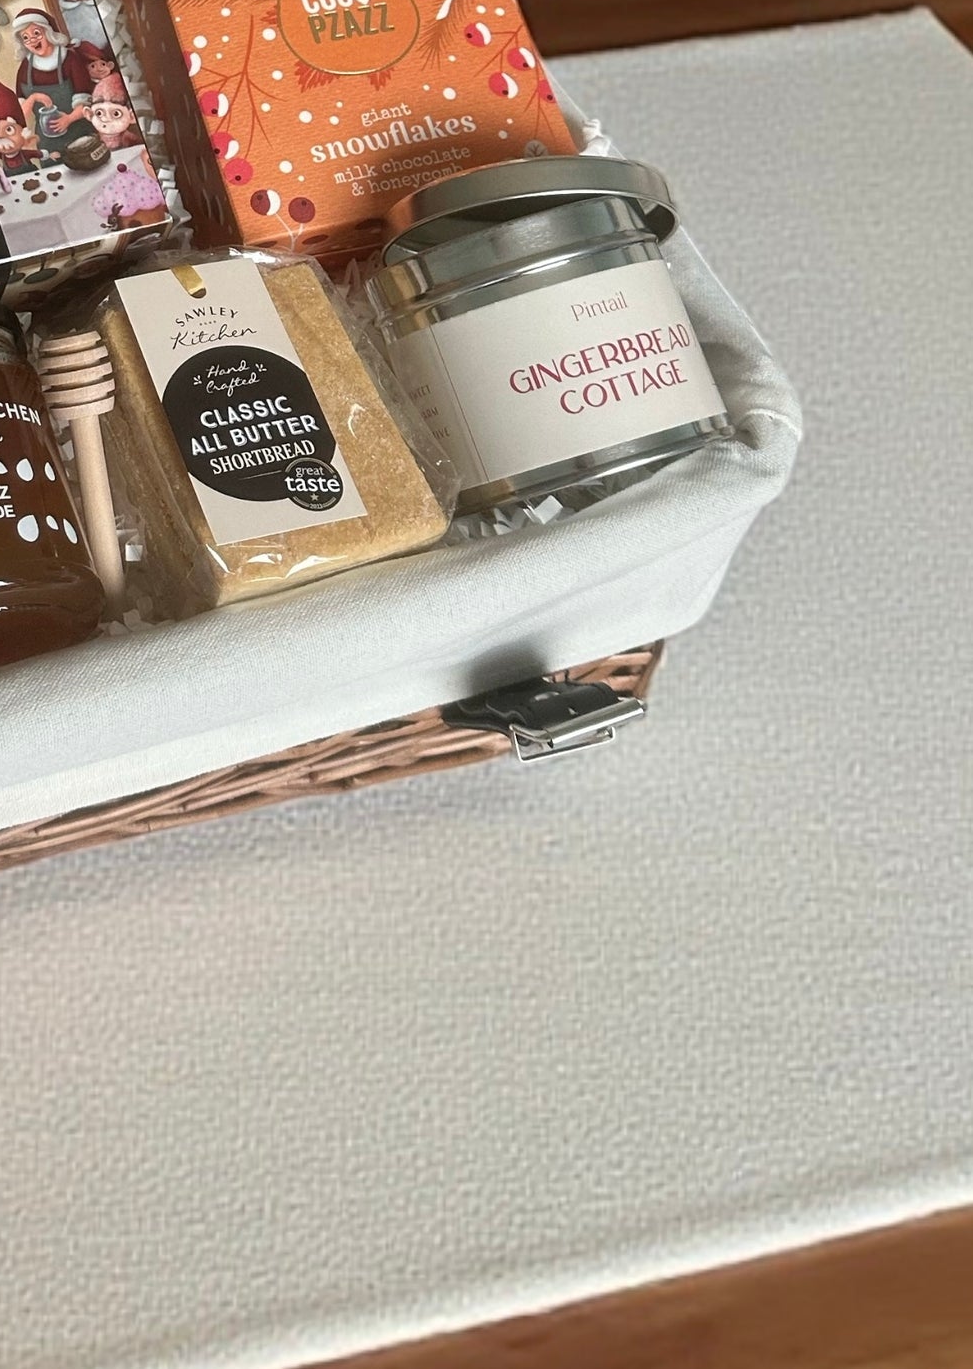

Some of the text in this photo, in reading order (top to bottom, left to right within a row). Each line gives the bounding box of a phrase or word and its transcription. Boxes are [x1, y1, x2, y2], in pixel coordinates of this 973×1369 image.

[307, 2, 395, 44] PZAZZ
[361, 102, 412, 127] giant
[309, 115, 477, 163] snowflakes
[333, 146, 472, 185] milk chocolate
[351, 163, 464, 197] & honeycomb
[175, 306, 238, 328] SAWLEY
[570, 291, 628, 322] Pintail
[171, 323, 257, 350] Kitchen
[206, 360, 250, 378] Hand
[509, 323, 691, 394] GINGERBREAD
[206, 372, 260, 397] Crafted
[559, 358, 688, 415] COTTAGE
[200, 395, 292, 429] CLASSIC
[191, 414, 320, 456] ALL BUTTER
[209, 439, 315, 475] SHORTBREAD
[295, 466, 325, 478] great
[284, 476, 340, 493] taste
